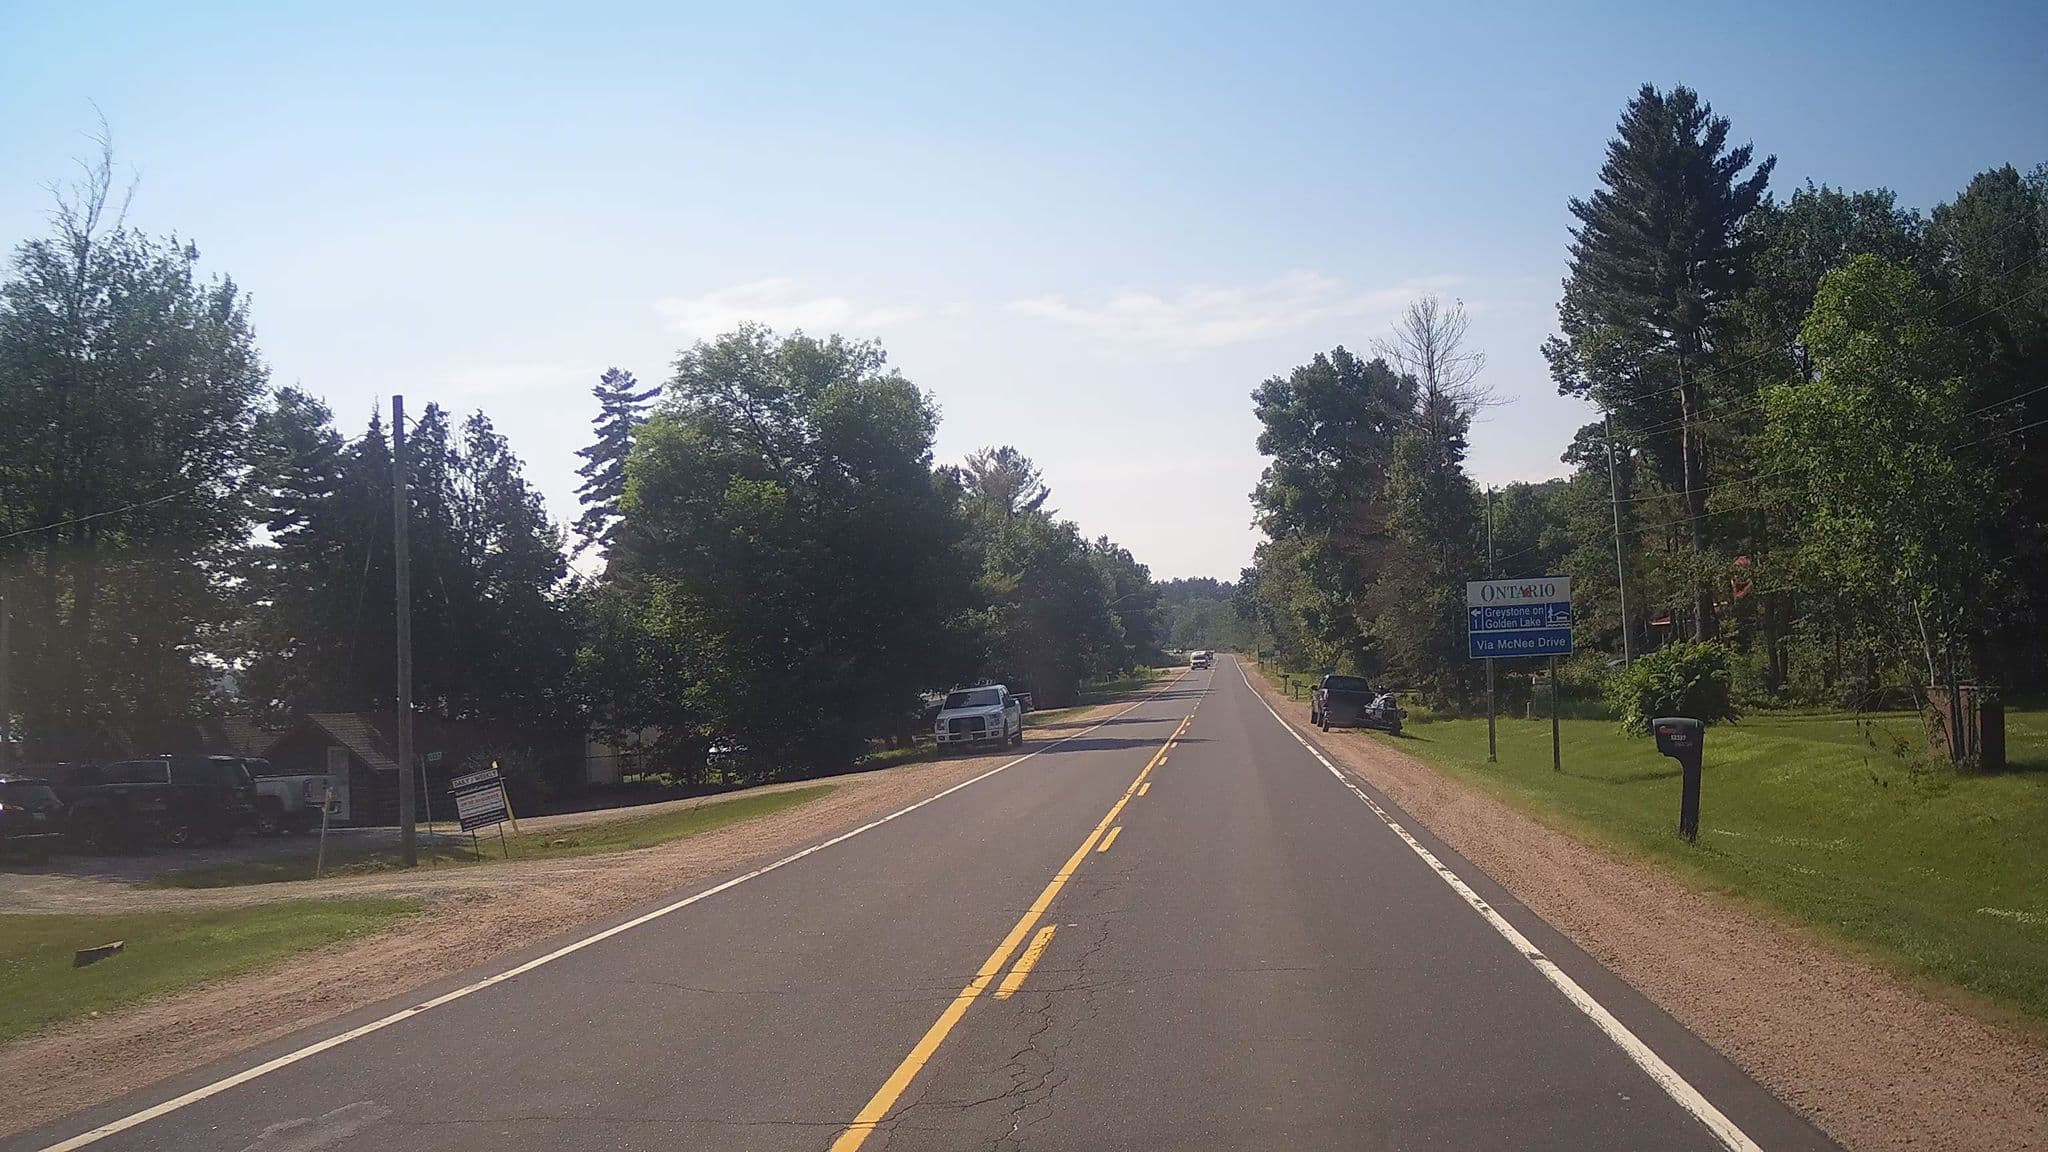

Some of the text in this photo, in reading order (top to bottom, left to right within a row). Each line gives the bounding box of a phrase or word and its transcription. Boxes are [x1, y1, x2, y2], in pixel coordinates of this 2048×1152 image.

[1481, 584, 1555, 602] ONTARIO
[1485, 607, 1544, 619] Greystone on
[1485, 617, 1541, 629] Golden Lake
[1477, 637, 1566, 650] Via McNee Drive
